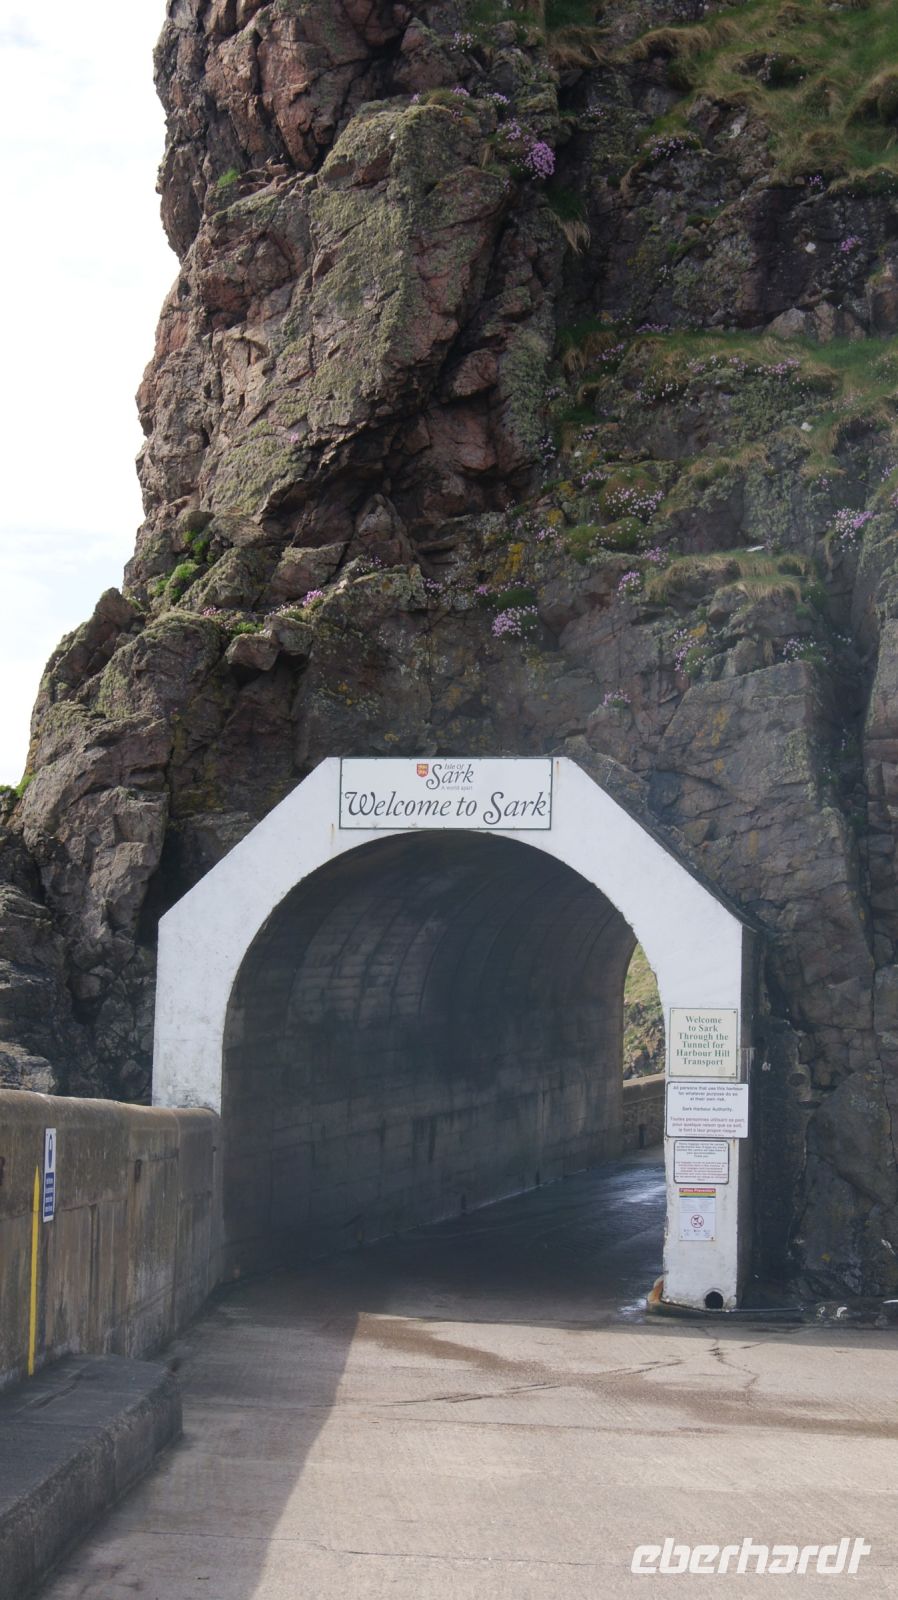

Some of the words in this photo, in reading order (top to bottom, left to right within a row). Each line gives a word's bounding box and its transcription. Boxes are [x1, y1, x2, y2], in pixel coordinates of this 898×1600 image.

[426, 764, 474, 790] Sark
[345, 791, 452, 816] Welcome
[456, 797, 477, 816] to
[483, 792, 546, 825] Sark
[686, 1016, 723, 1024] Welcome
[679, 1032, 713, 1041] Through
[683, 1058, 723, 1066] Transport
